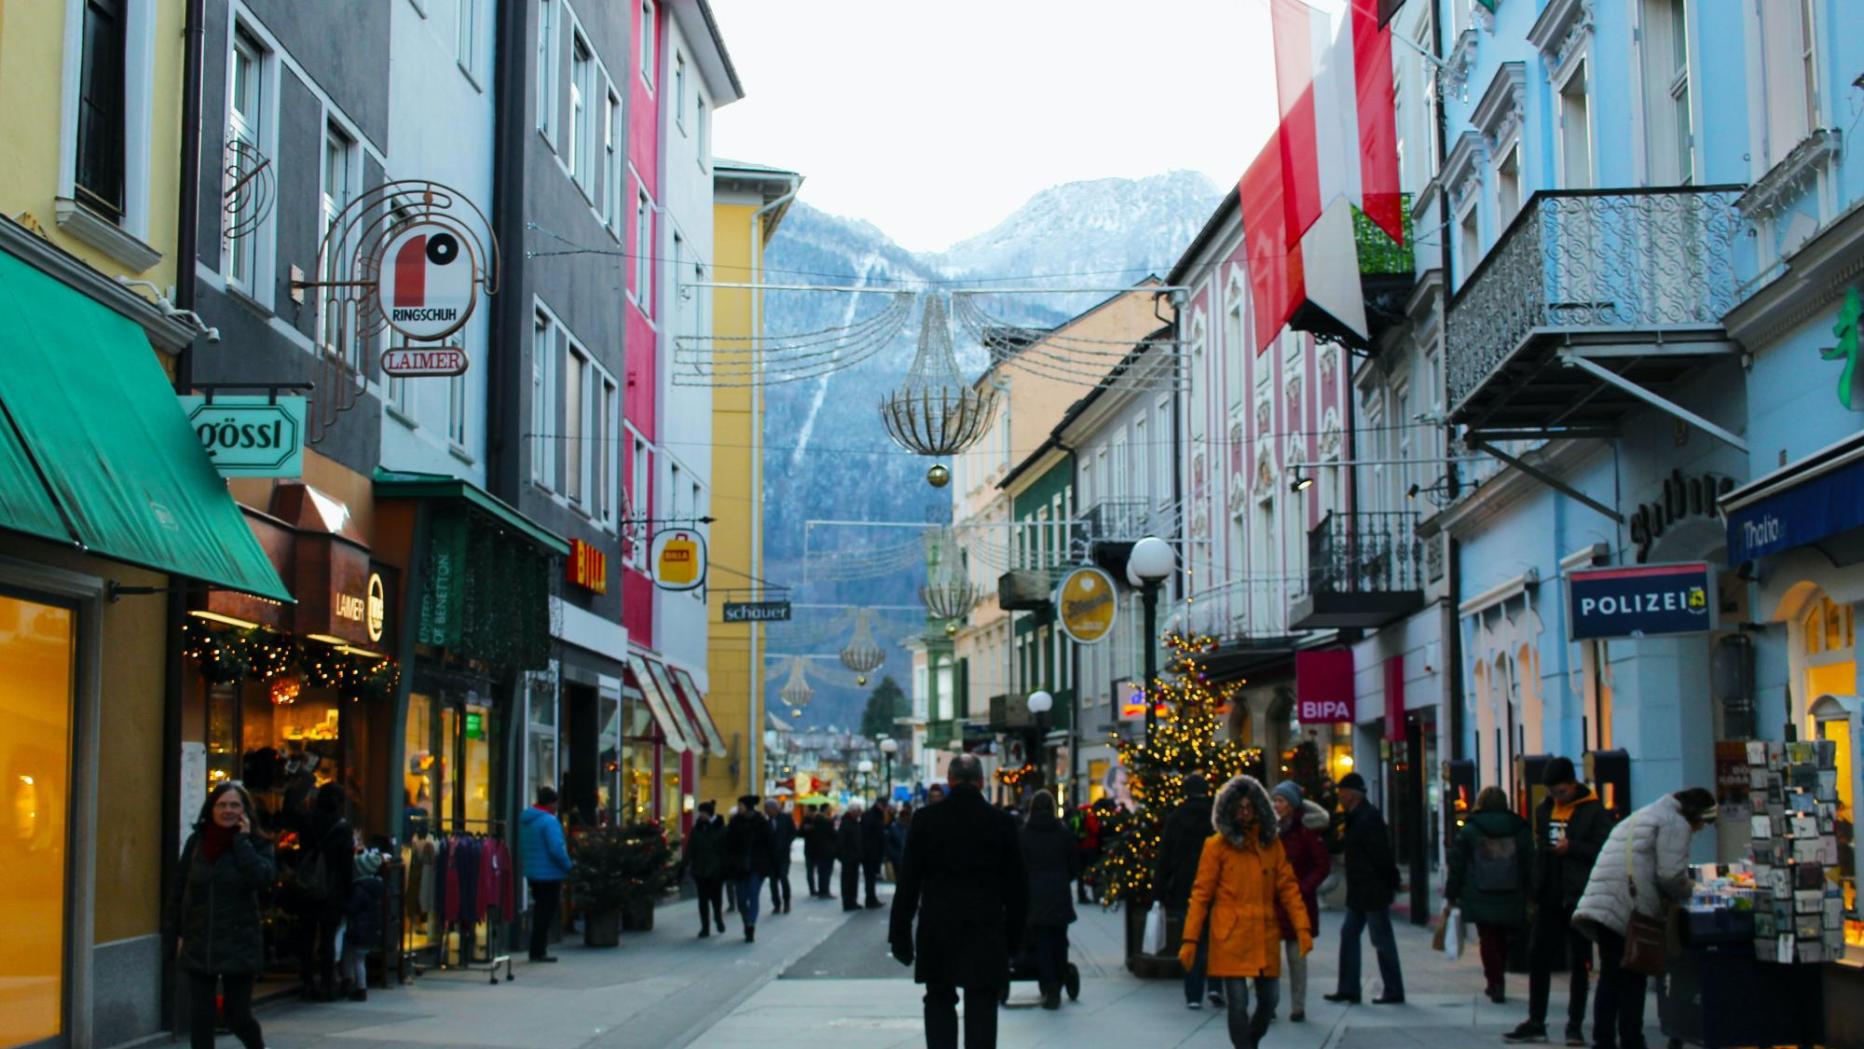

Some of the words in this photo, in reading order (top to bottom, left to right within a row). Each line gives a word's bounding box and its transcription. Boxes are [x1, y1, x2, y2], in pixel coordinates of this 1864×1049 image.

[393, 308, 457, 321] RINGSCHUH
[388, 352, 460, 369] LAIMER
[196, 417, 282, 457] gössl
[1744, 513, 1779, 549] Thalia
[434, 554, 449, 624] BENETTON
[725, 605, 788, 619] schauer
[1581, 591, 1687, 616] POLIZEI
[433, 627, 445, 645] OF
[1302, 701, 1350, 719] BIPA
